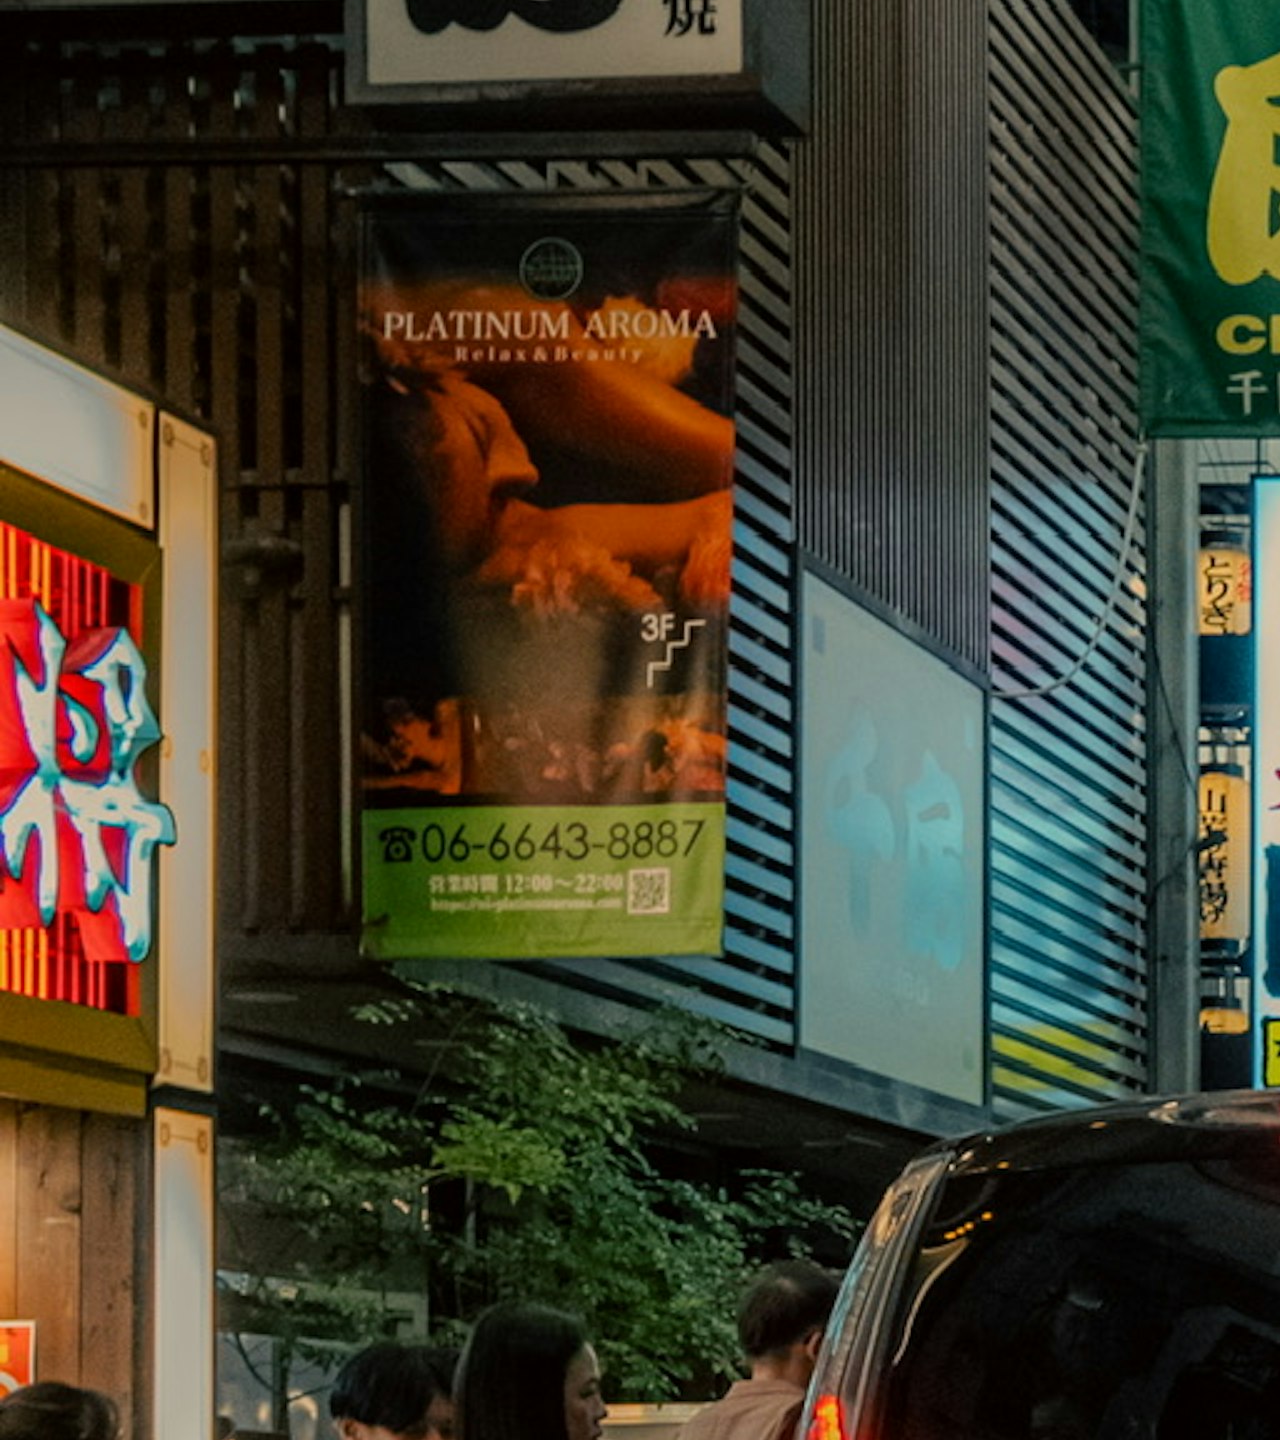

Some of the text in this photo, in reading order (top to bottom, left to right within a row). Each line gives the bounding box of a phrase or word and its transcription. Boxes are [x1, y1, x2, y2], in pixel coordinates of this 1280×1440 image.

[383, 308, 717, 343] PLATINUM AROMA
[640, 614, 676, 643] 3F
[421, 819, 705, 862] 06-6643-8887
